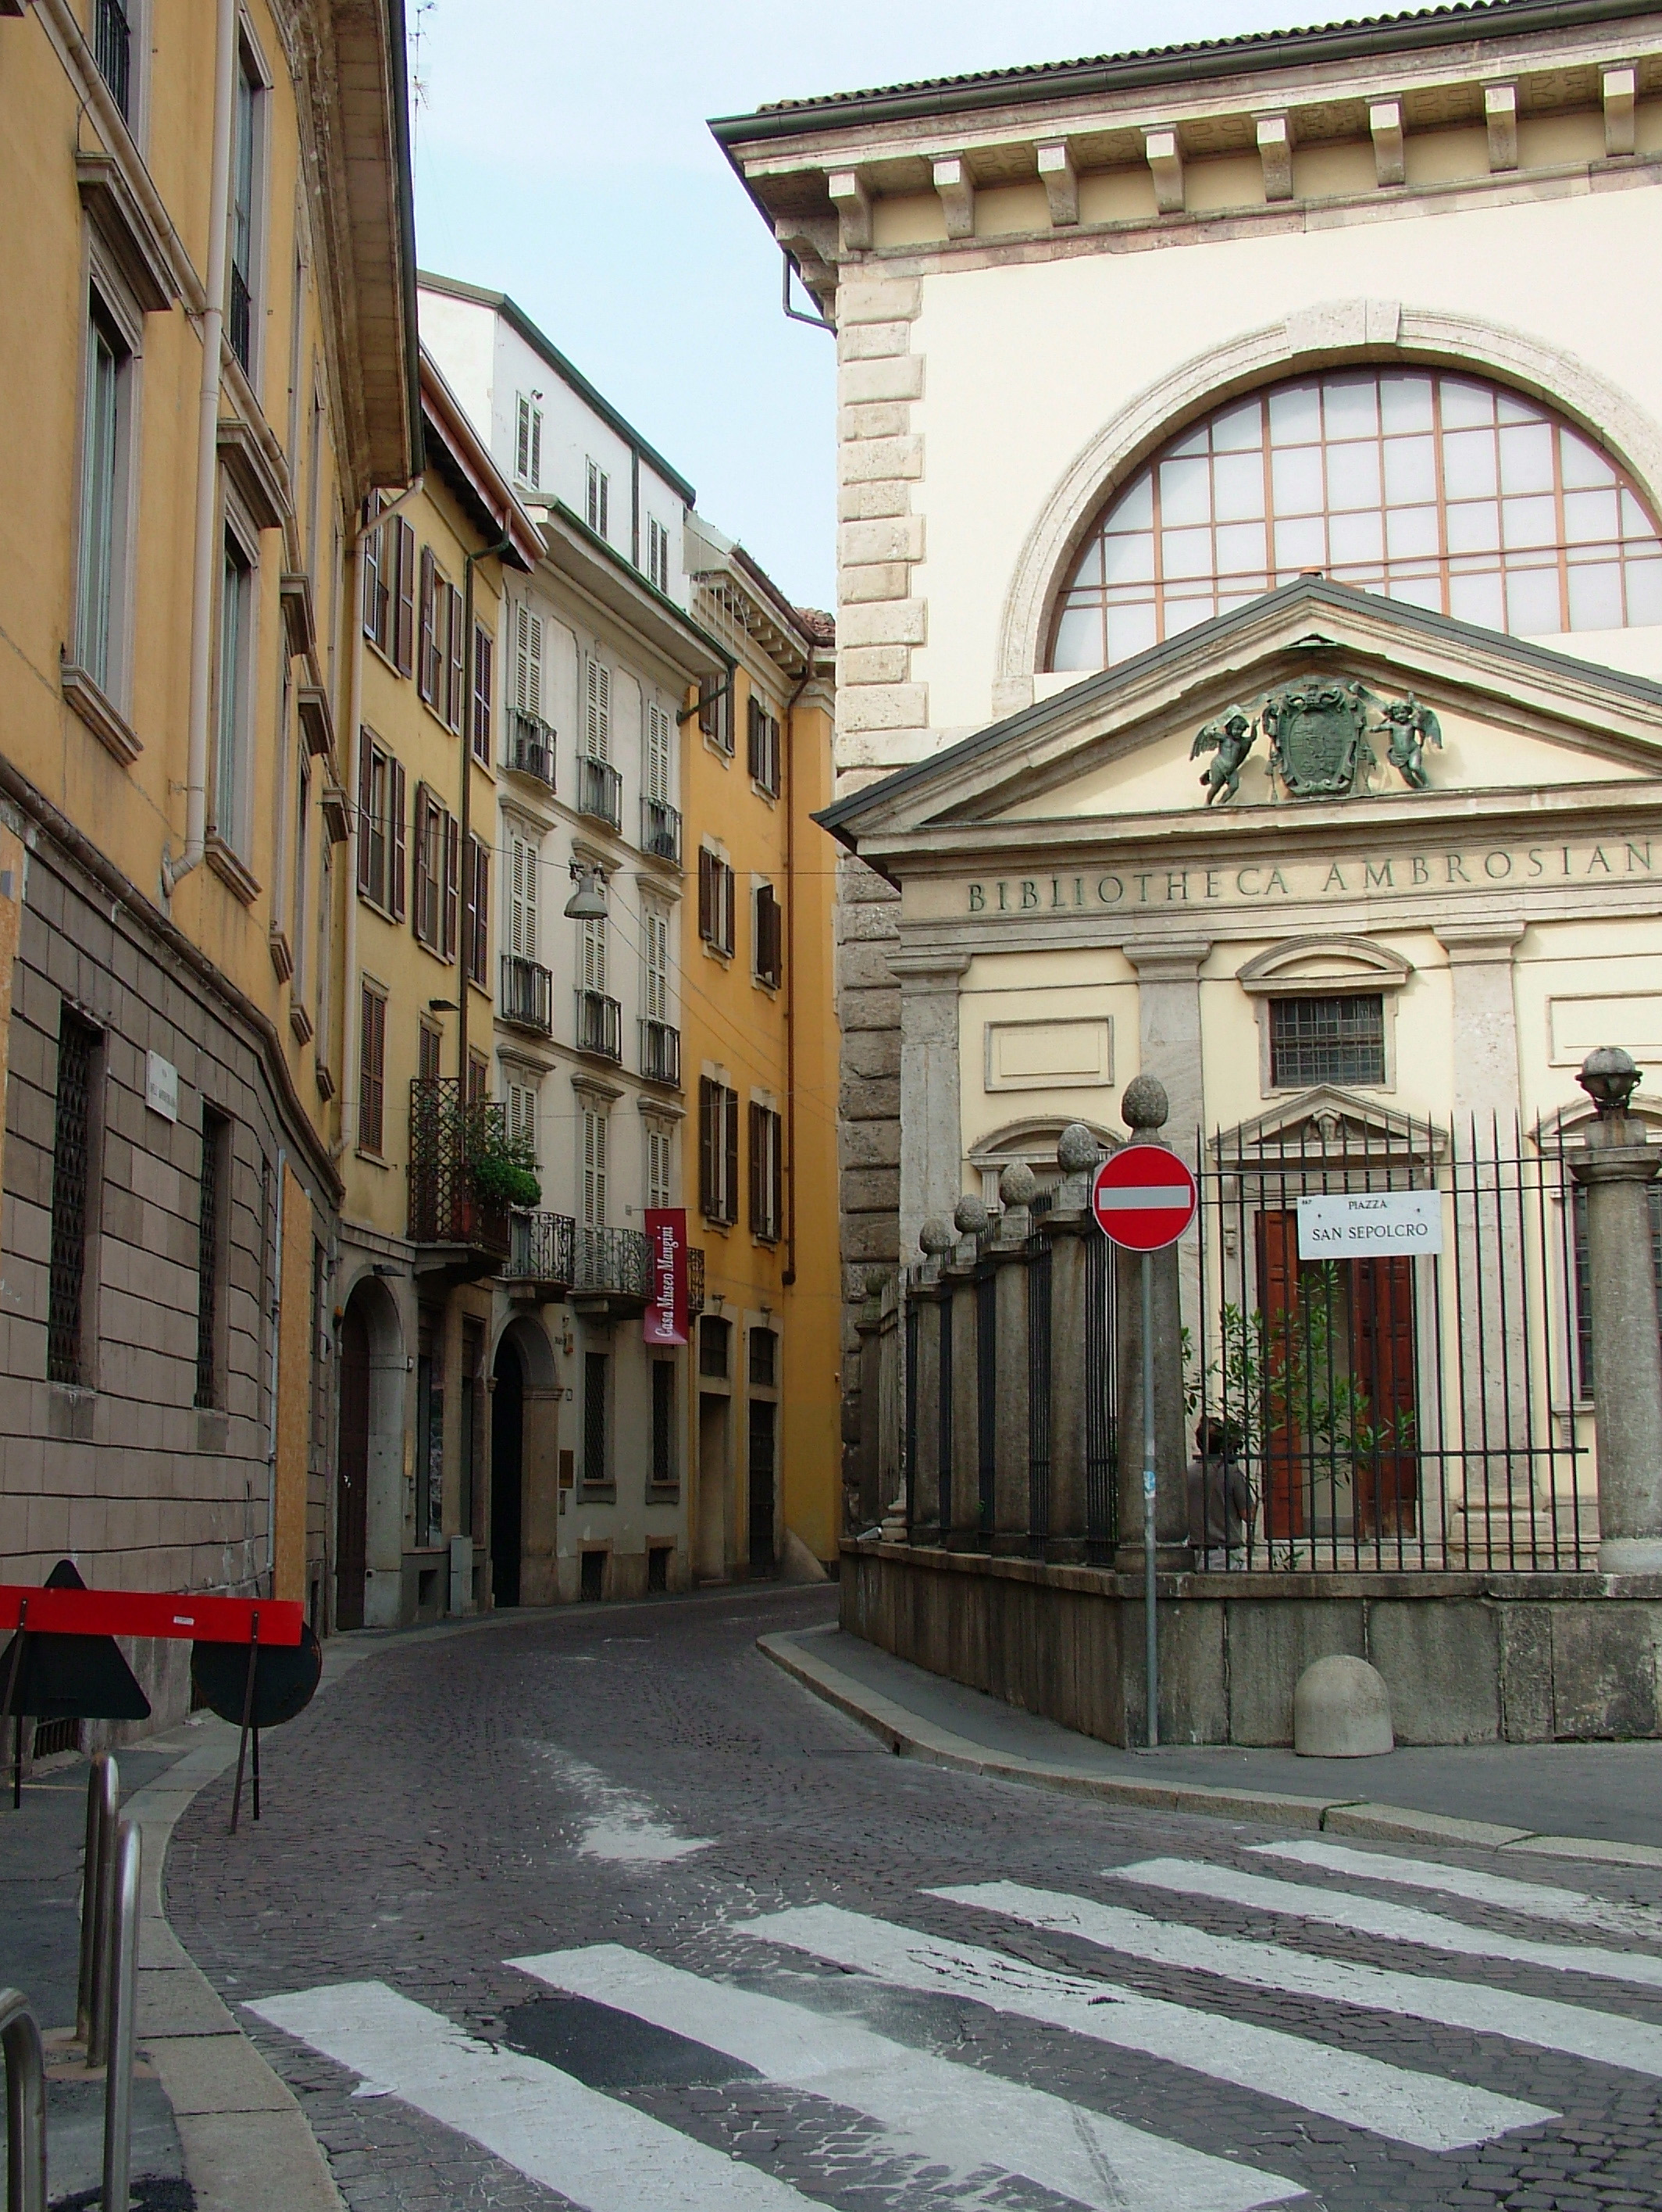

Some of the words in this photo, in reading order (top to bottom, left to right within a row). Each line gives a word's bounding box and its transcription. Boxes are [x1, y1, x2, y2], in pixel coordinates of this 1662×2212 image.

[968, 866, 1289, 912] BIBLIOTHECA
[1321, 842, 1652, 892] AMBROSIAN
[1348, 1200, 1388, 1210] PIAZZA
[1312, 1227, 1342, 1241] SAN
[1348, 1222, 1428, 1239] SEPOLCRO
[657, 1226, 679, 1270] Mangini
[657, 1273, 674, 1308] Museo
[654, 1311, 674, 1337] Casa
